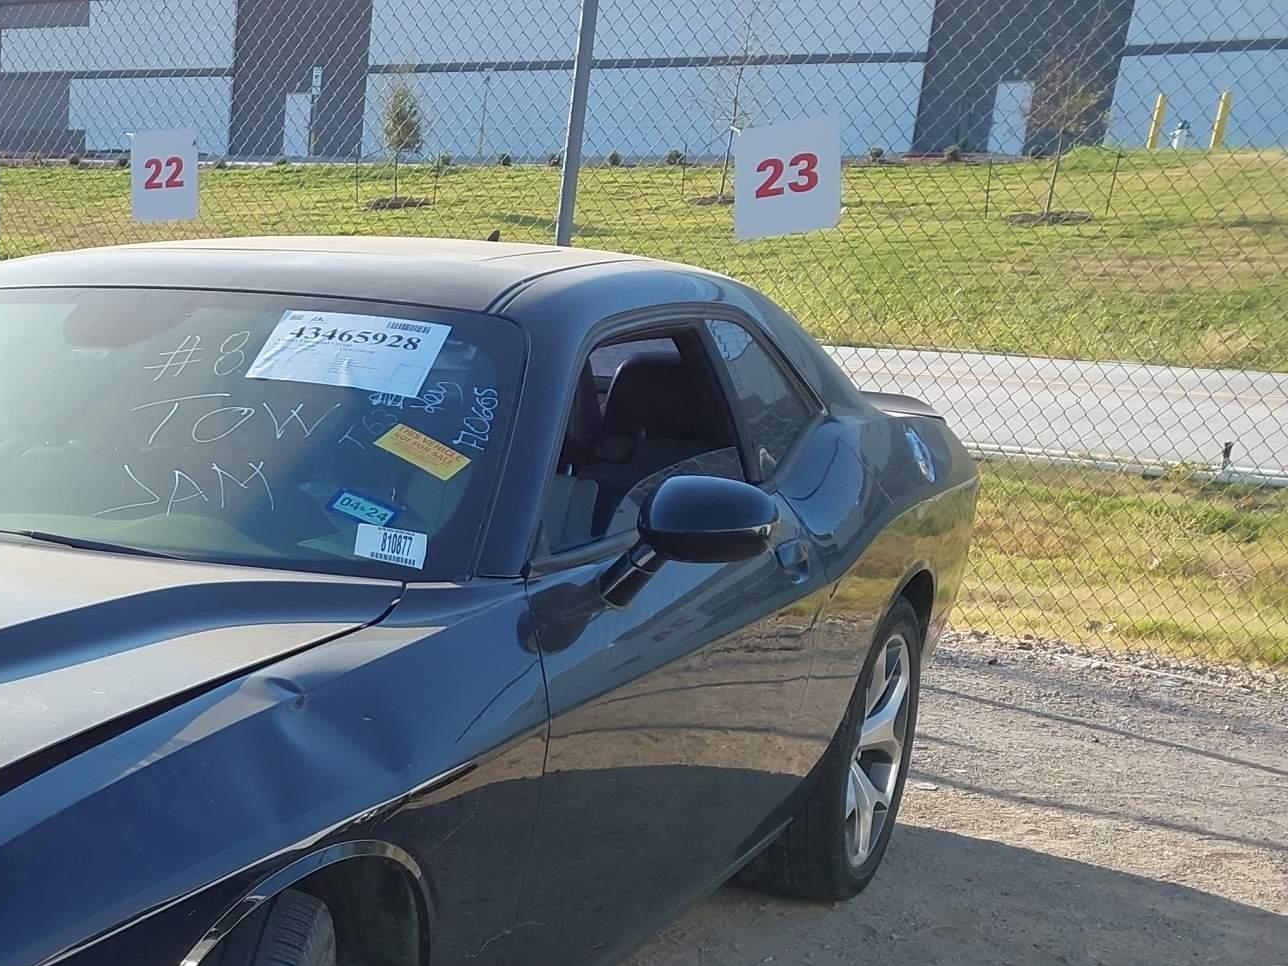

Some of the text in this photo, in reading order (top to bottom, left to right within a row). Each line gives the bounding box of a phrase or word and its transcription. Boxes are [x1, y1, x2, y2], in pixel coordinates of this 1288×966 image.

[144, 156, 185, 190] 22
[755, 152, 819, 198] 23
[288, 325, 422, 352] 43465928
[131, 393, 342, 445] TOW
[392, 431, 454, 465] NOT FOR SALE
[398, 424, 421, 439] THIS
[420, 437, 464, 462] VEHICLE
[380, 531, 414, 557] 810877
